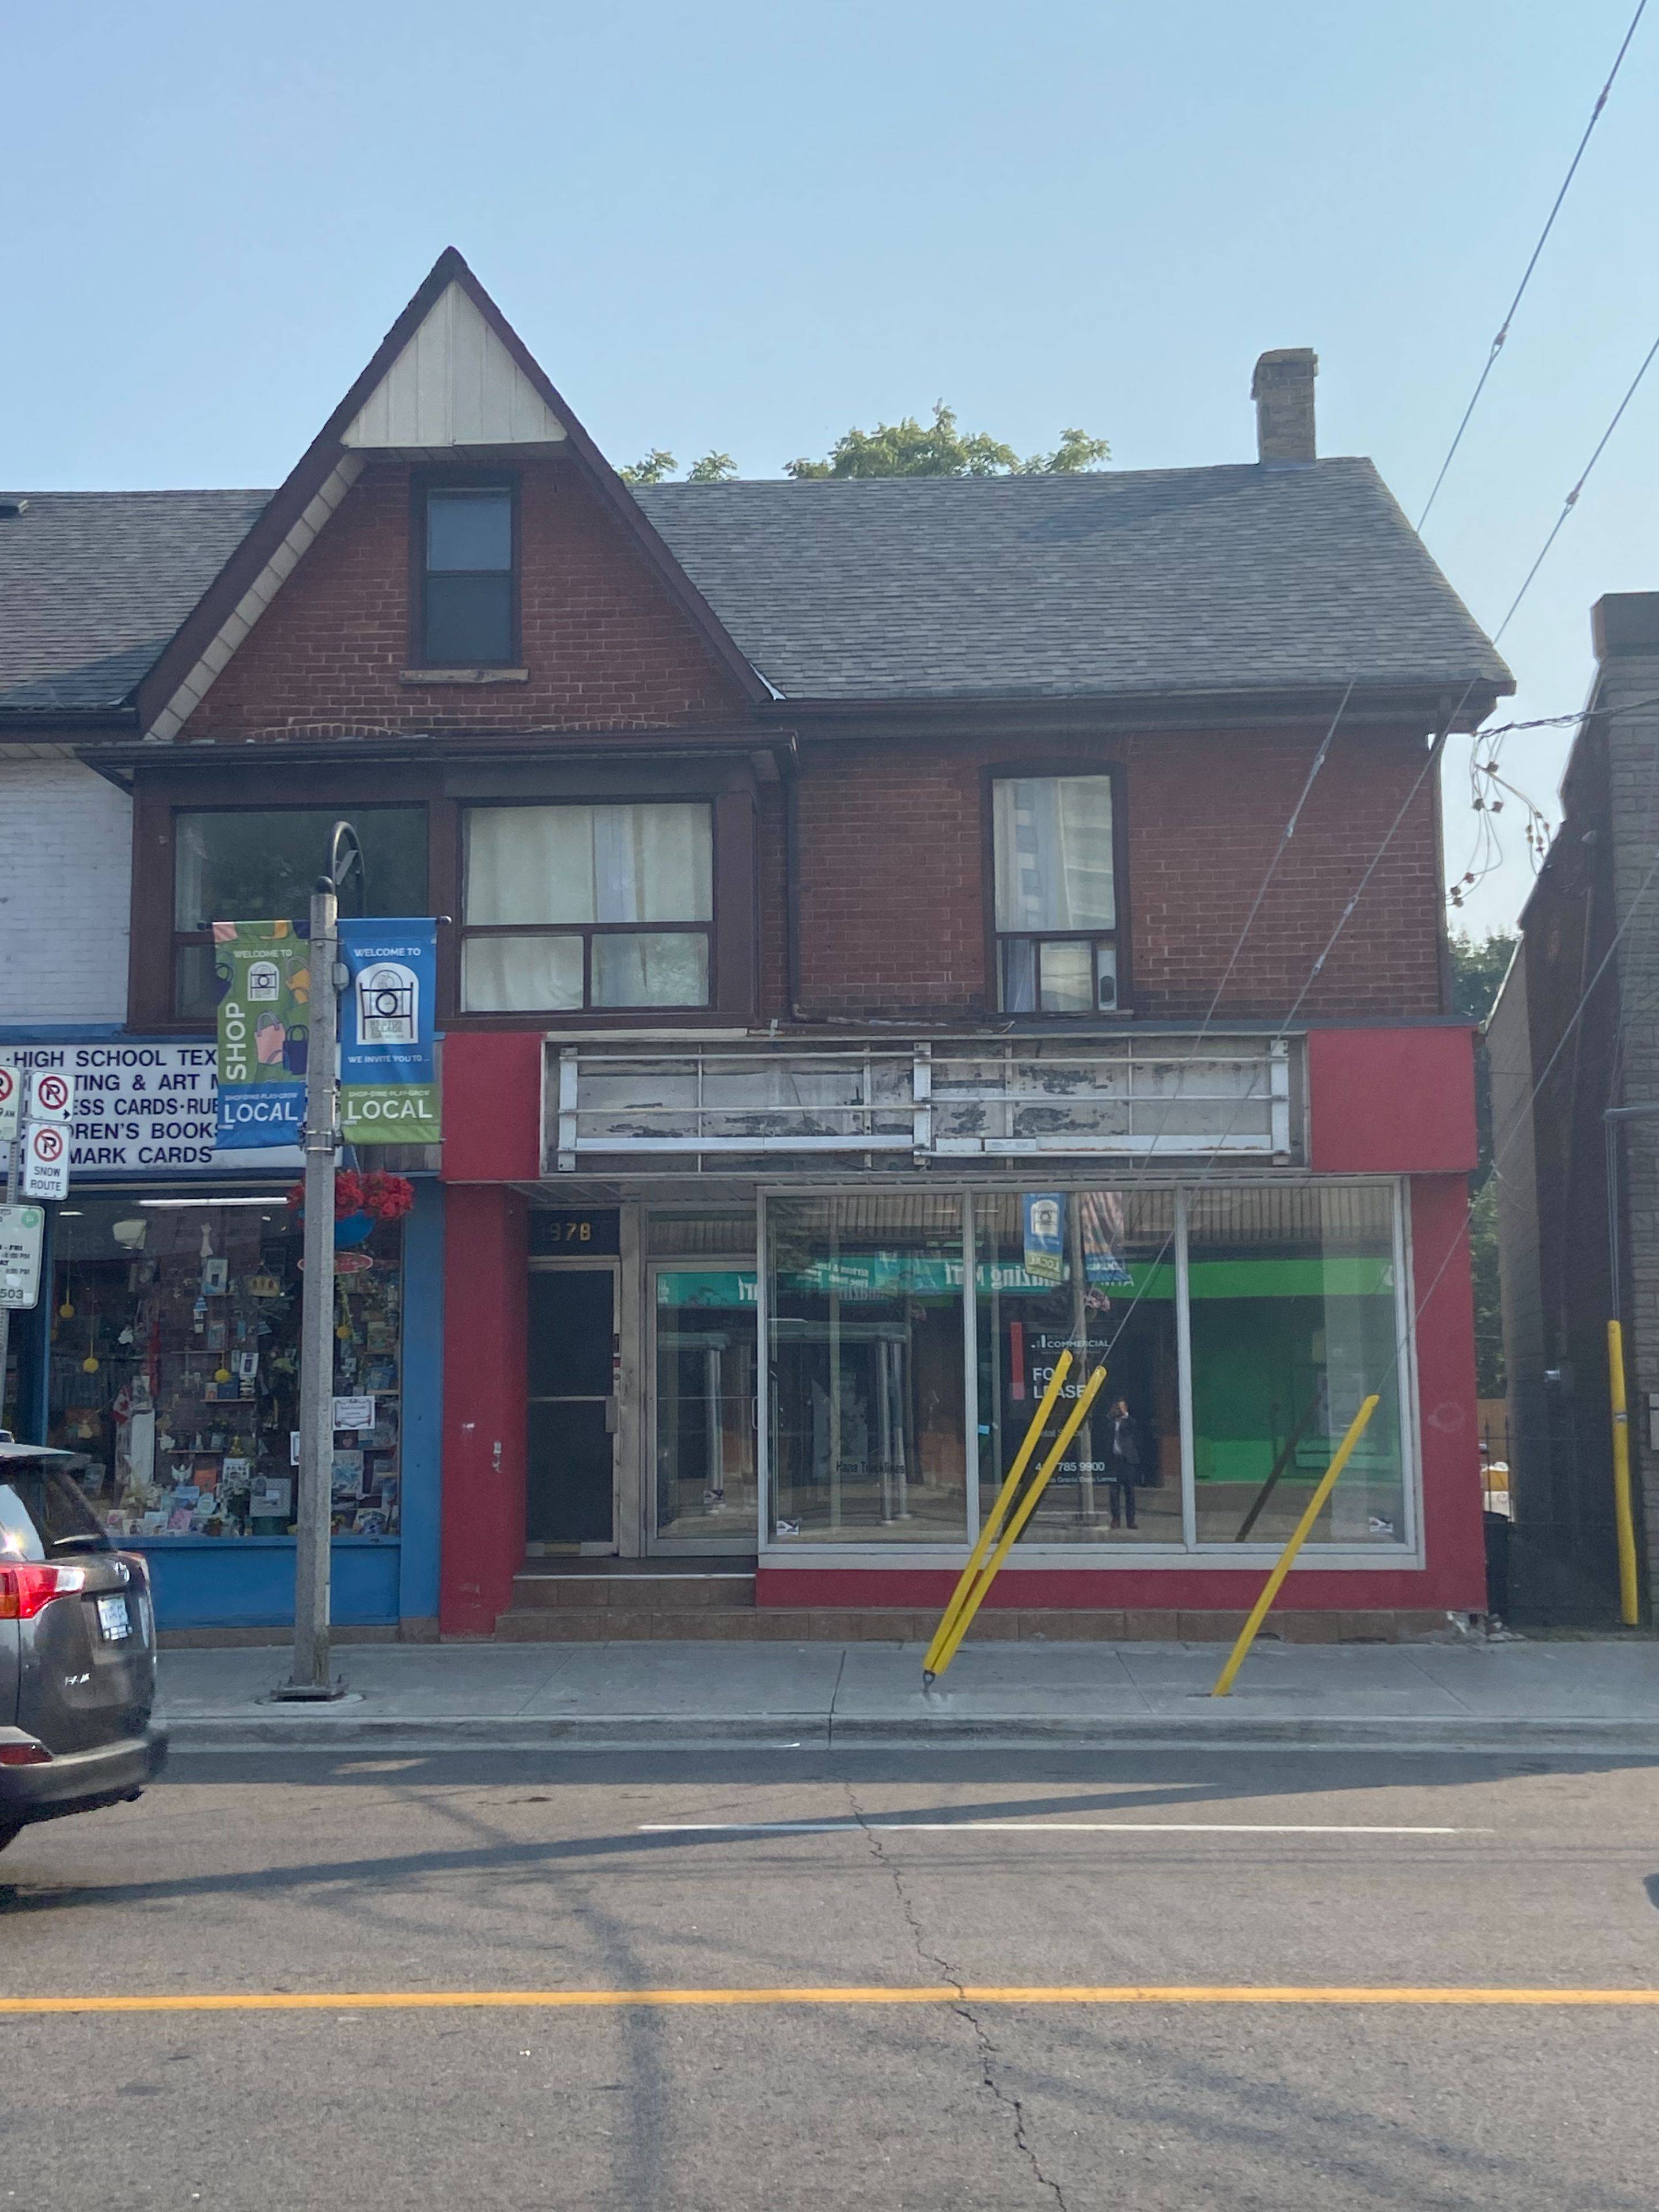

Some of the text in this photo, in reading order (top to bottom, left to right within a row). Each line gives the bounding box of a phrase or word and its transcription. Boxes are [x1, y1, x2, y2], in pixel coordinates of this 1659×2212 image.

[233, 949, 293, 958] WELCOME TO
[353, 948, 421, 956] WELCOME TO
[225, 1002, 247, 1081] SHOP
[75, 1050, 166, 1066] SCHOOL
[132, 1074, 146, 1090] &
[158, 1074, 200, 1090] ART
[225, 1102, 298, 1123] LOCAL
[348, 1100, 433, 1119] LOCAL
[138, 1146, 213, 1164] CARDS
[34, 1166, 61, 1177] SNOW
[31, 1179, 62, 1191] ROUTE
[550, 1222, 591, 1241] 978
[1047, 1340, 1111, 1349] COMMERCIAL
[1058, 1462, 1105, 1471] 785 9900
